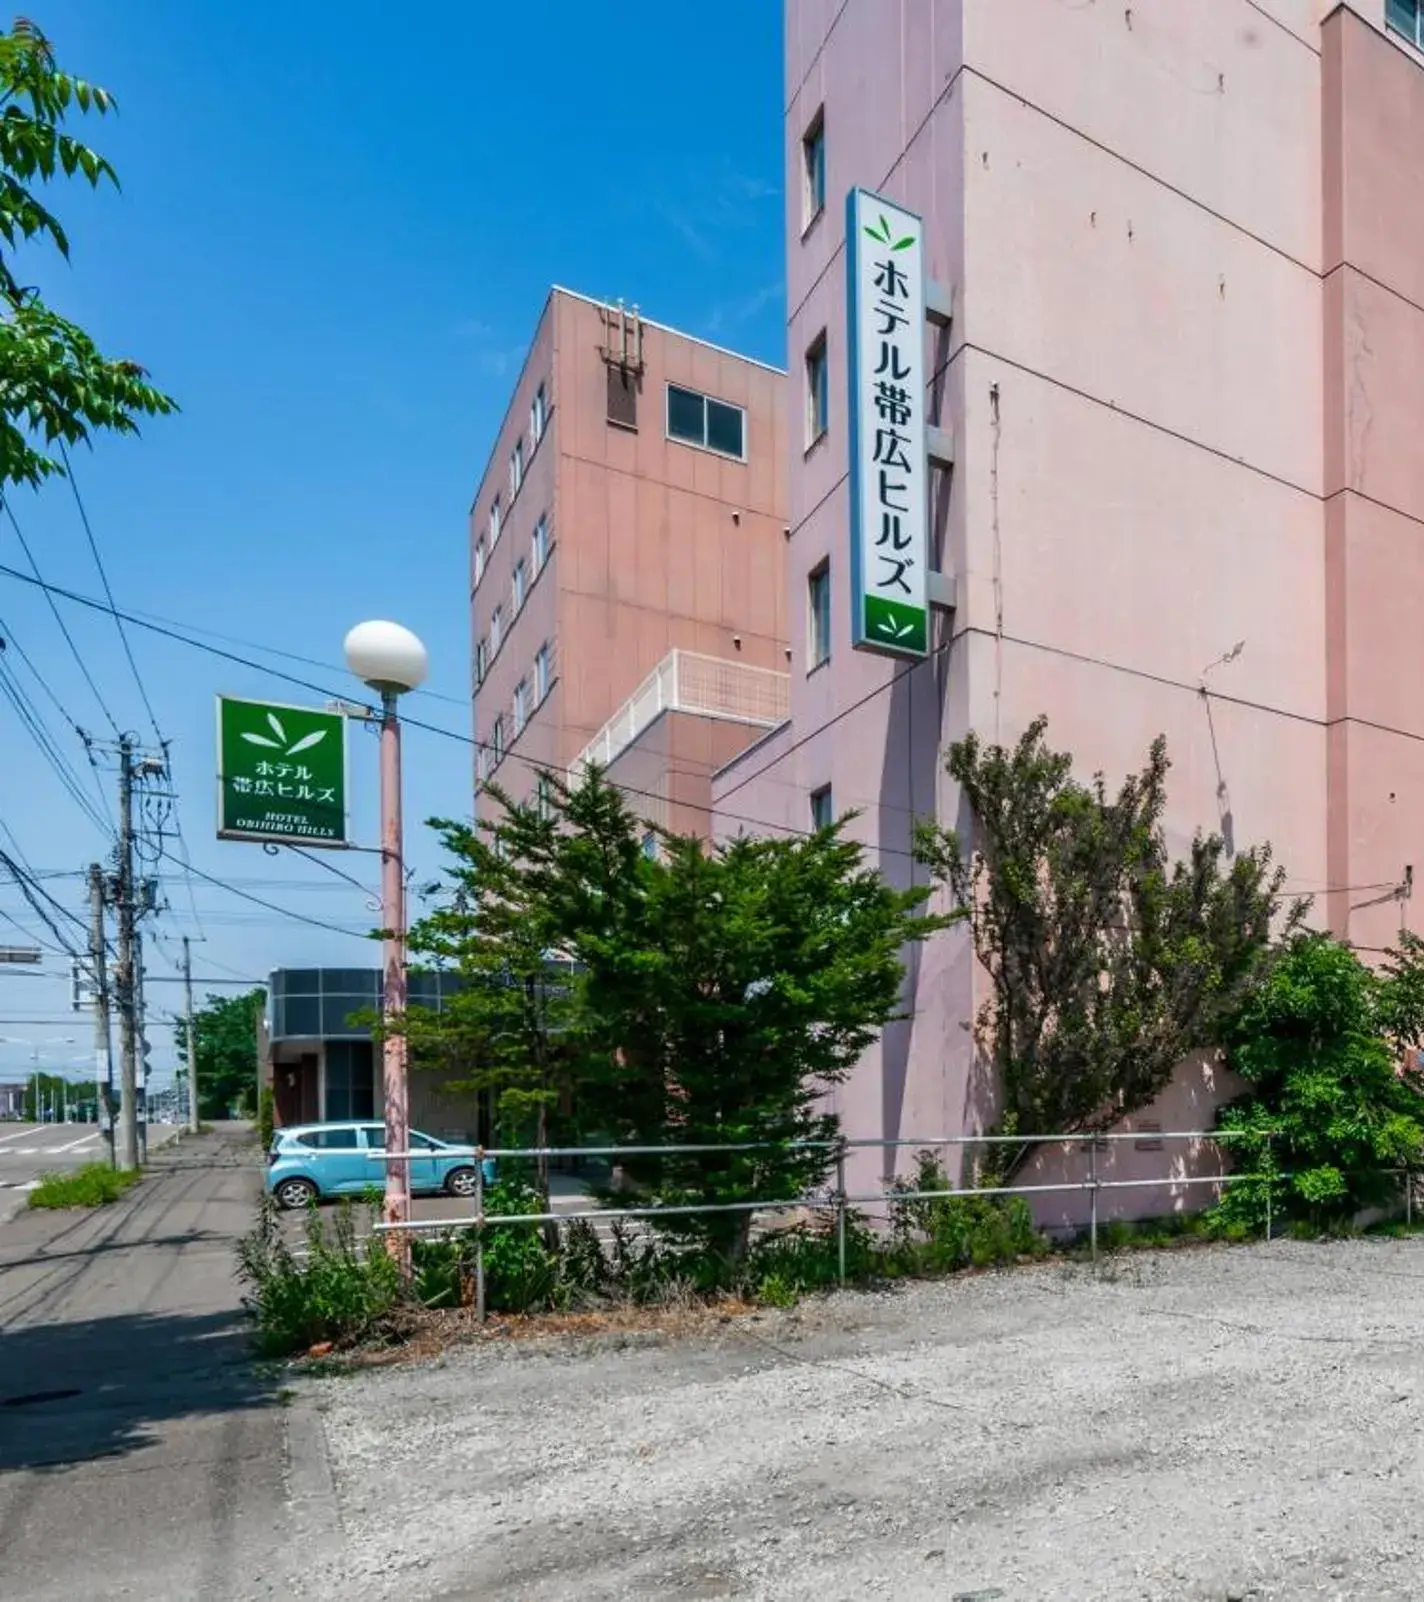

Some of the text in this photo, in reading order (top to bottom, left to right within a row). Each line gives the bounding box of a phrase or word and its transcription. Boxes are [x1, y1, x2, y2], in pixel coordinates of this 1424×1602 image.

[872, 259, 914, 595] ホテル帯広ヒルズ
[255, 760, 313, 780] ホテル
[232, 775, 336, 802] 帯広ヒルズ
[236, 818, 336, 837] OBIHIRO HILLS
[265, 811, 309, 825] HOTEL
